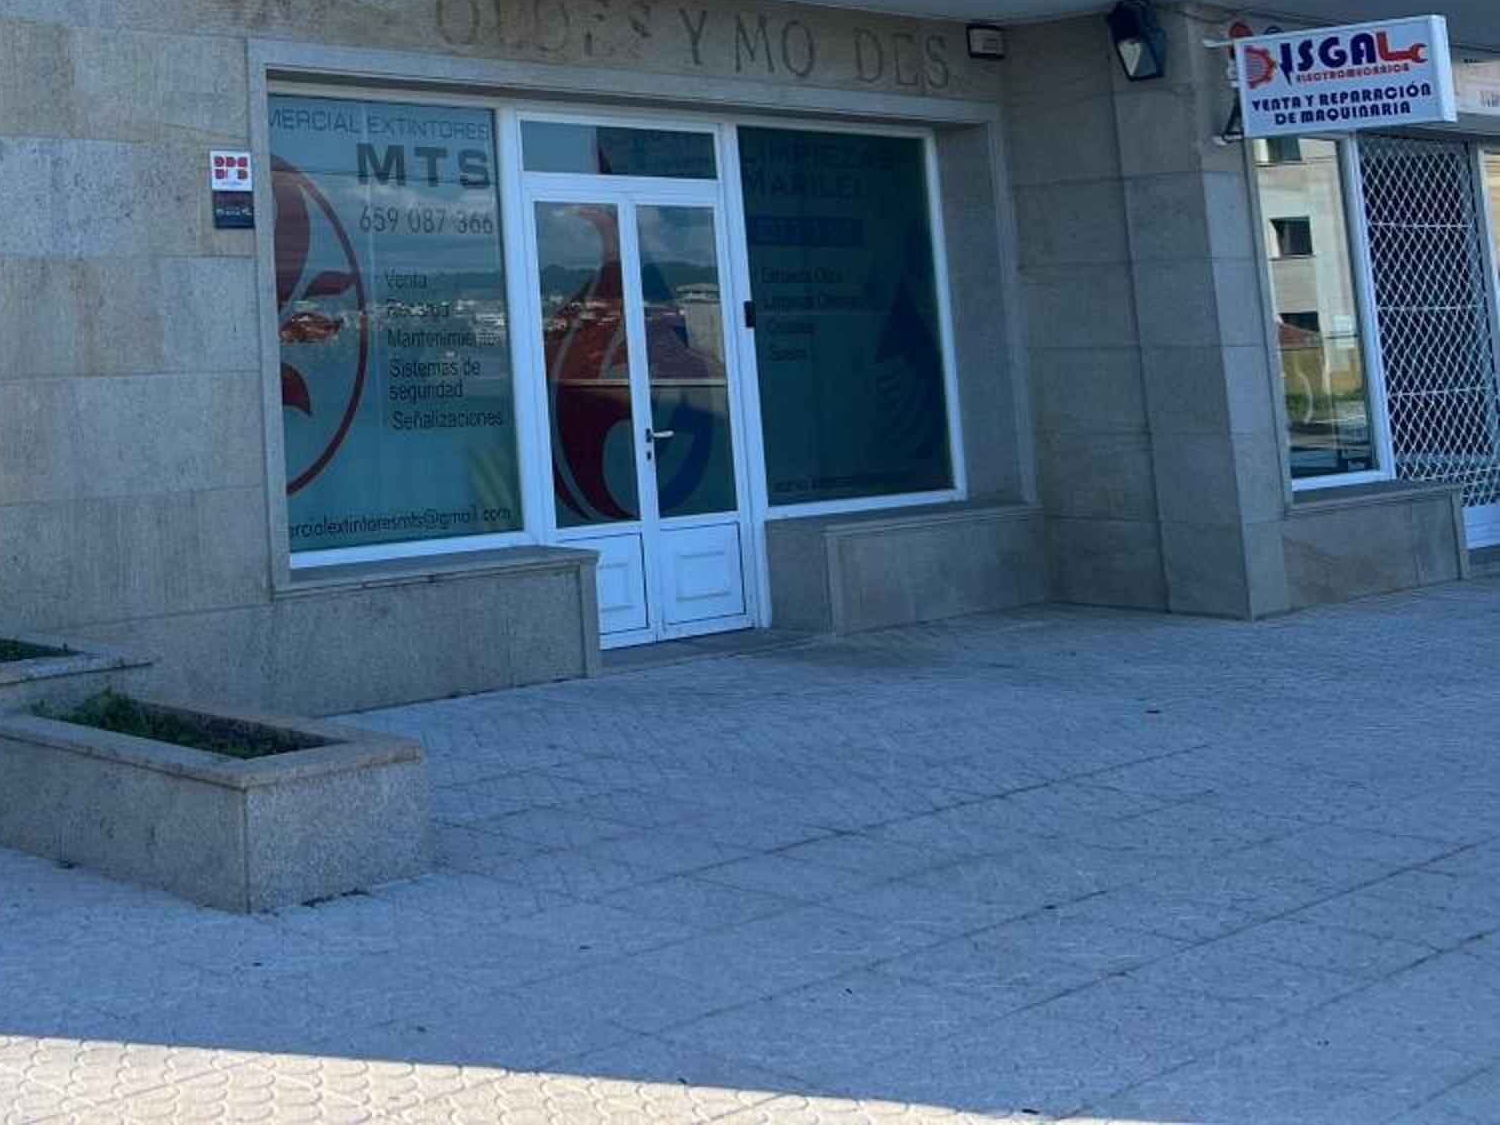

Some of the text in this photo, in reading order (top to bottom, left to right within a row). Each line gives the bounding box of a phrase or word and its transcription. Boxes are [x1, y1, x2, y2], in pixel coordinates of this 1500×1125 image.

[1252, 81, 1431, 113] VENTA Y REPARACIÓN
[1275, 100, 1411, 125] DE MAQUINARIA
[356, 143, 490, 189] MTS
[359, 206, 494, 234] 659 087 366
[389, 356, 482, 379] Sistemas de
[389, 379, 463, 404] seguridad
